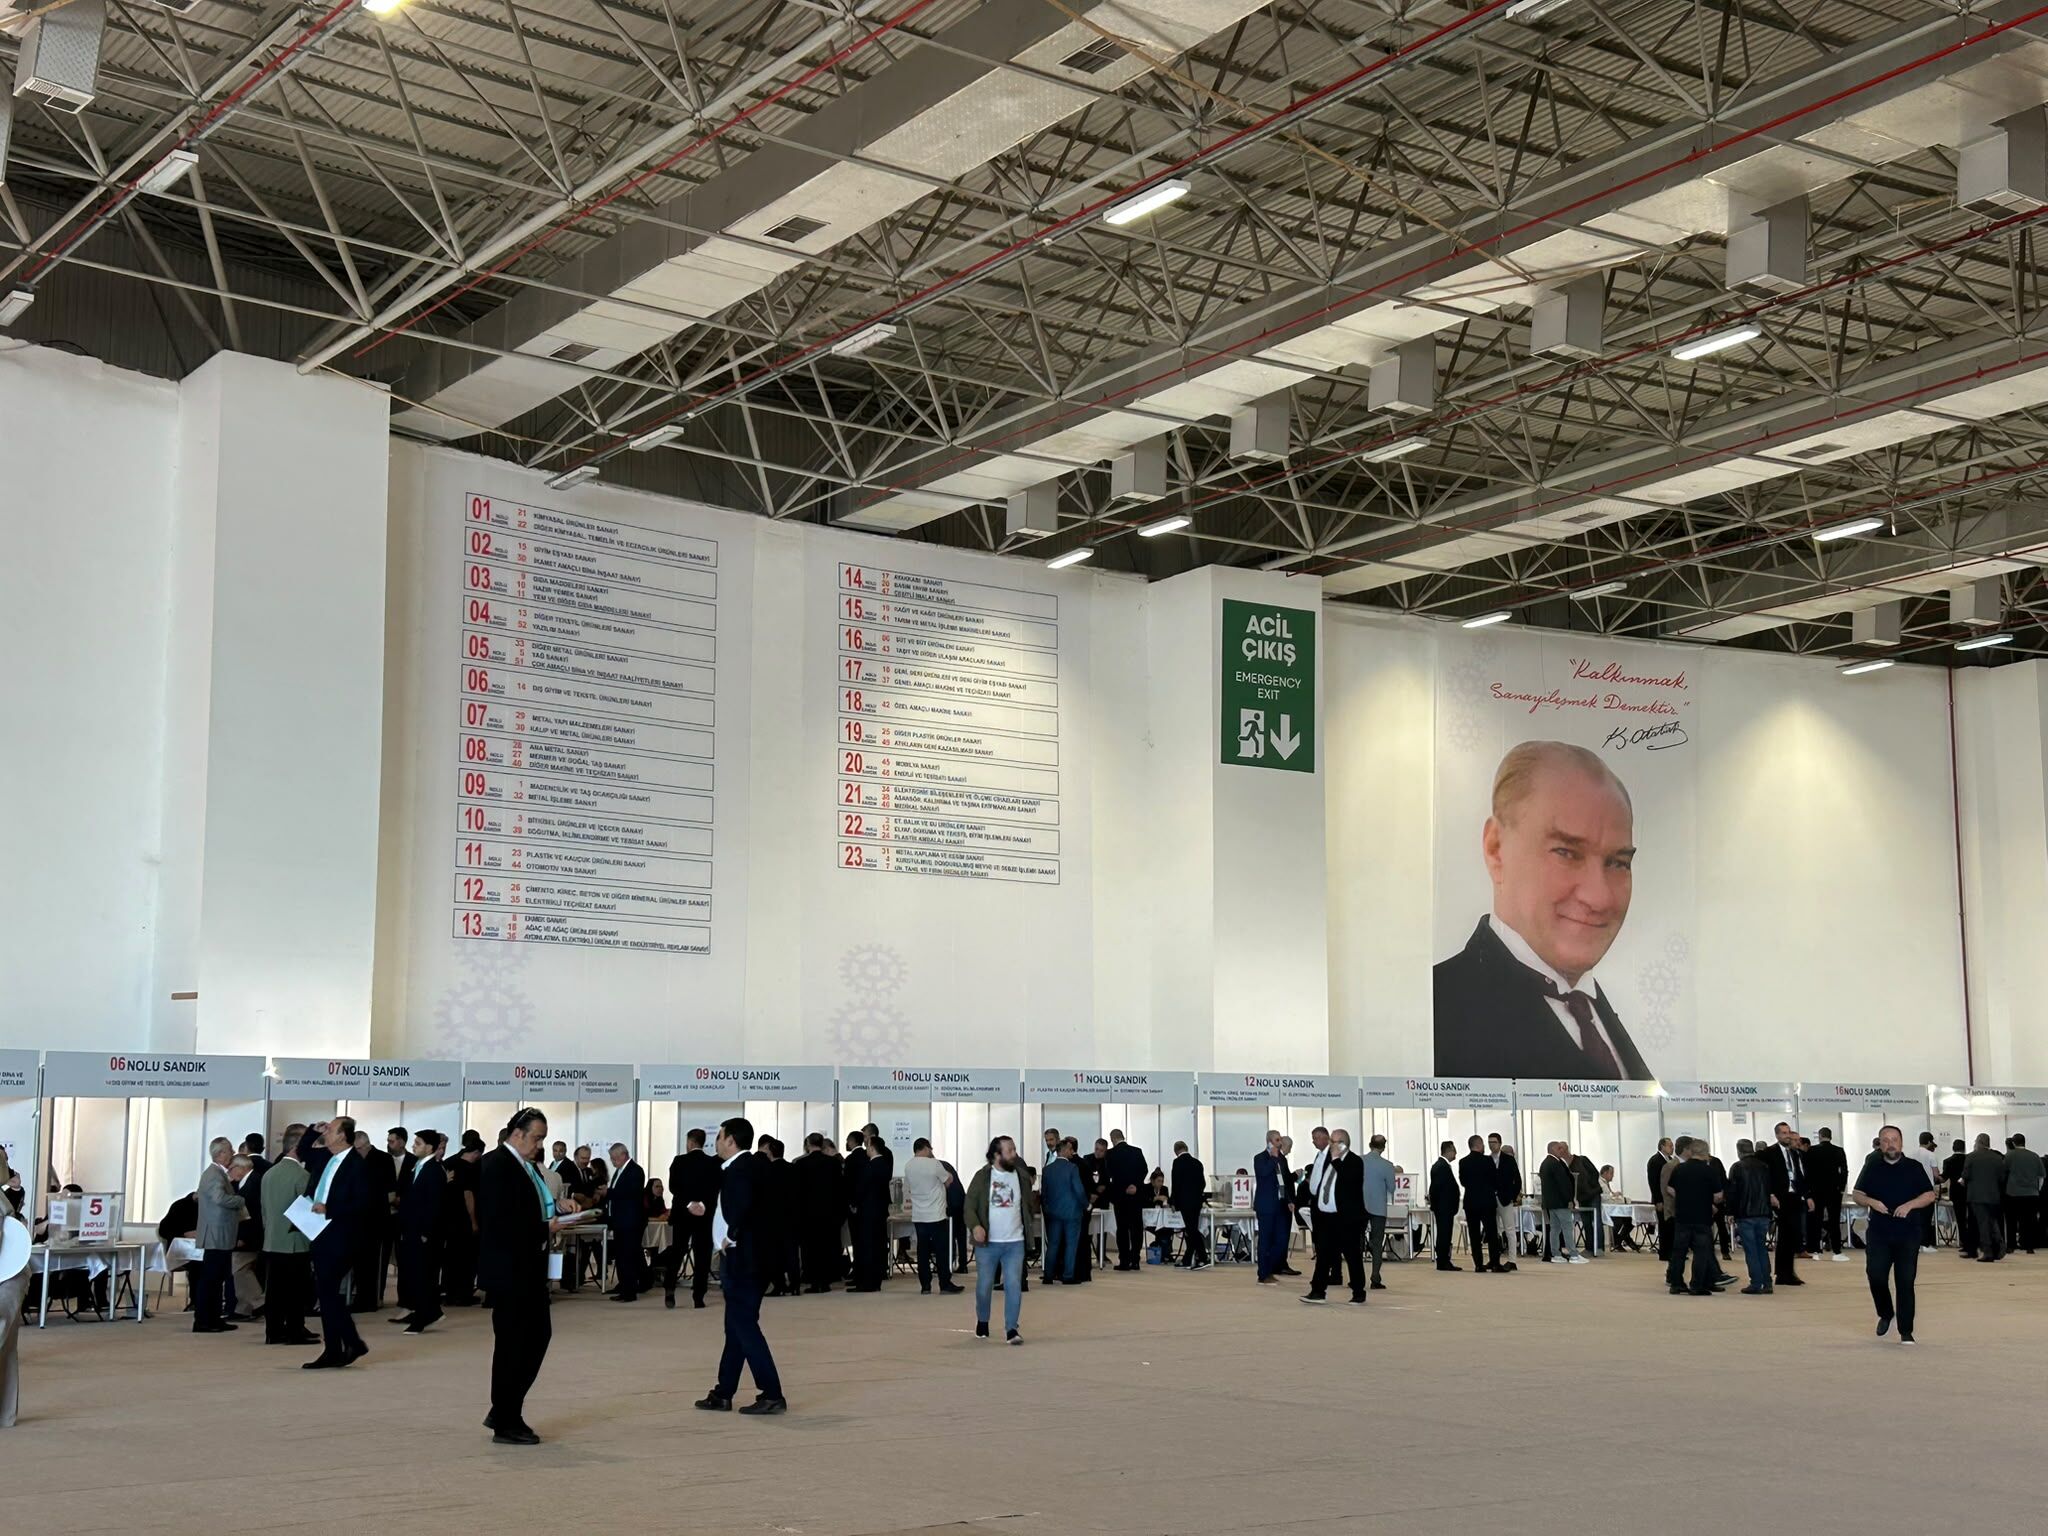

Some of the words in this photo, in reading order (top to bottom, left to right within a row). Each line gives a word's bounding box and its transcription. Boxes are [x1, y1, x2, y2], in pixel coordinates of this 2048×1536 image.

[472, 496, 490, 522] 01
[518, 509, 526, 517] 21
[518, 521, 527, 529] 22
[472, 531, 491, 556] 02
[470, 565, 491, 590] 03
[517, 581, 526, 589] 10
[846, 567, 862, 588] 14
[469, 600, 490, 624] 04
[518, 609, 527, 617] 13
[845, 598, 862, 619] 15
[517, 620, 527, 629] 52
[1246, 613, 1292, 638] ACİL
[469, 635, 489, 659] 05
[846, 628, 862, 650] 16
[1241, 638, 1296, 666] ÇIKIŞ
[846, 660, 862, 680] 17
[1236, 672, 1301, 688] EMERGENCY
[468, 669, 488, 692] 06
[846, 690, 862, 711] 18
[1258, 688, 1280, 700] EXIT
[1490, 682, 1597, 714] Sanayileşmek
[467, 703, 487, 727] 07
[515, 711, 525, 720] 29
[532, 714, 553, 724] METAL
[846, 721, 861, 742] 19
[466, 737, 486, 761] 08
[845, 752, 862, 773] 20
[464, 772, 485, 796] 09
[845, 783, 861, 804] 21
[465, 807, 484, 831] 10
[845, 814, 863, 836] 22
[465, 842, 482, 865] 11
[512, 849, 522, 857] 23
[845, 845, 862, 867] 23
[464, 878, 484, 901] 12
[511, 884, 521, 892] 26
[462, 912, 482, 936] 13
[110, 1057, 126, 1070] 06
[127, 1060, 160, 1072] NOLU
[163, 1061, 206, 1072] SANDIK
[328, 1062, 341, 1076] 07
[342, 1066, 370, 1076] NOLU
[373, 1066, 410, 1076] SANDIK
[515, 1066, 526, 1078] 08
[528, 1069, 551, 1079] NOLU
[554, 1069, 587, 1079] SANDIK
[696, 1068, 709, 1080] 09
[711, 1070, 739, 1080] NOLU
[742, 1071, 780, 1081] SANDIK
[892, 1070, 904, 1082] 10
[905, 1072, 931, 1082] NOLU
[934, 1073, 970, 1082] SANDIK
[1074, 1073, 1084, 1083] 11
[1086, 1075, 1111, 1084] NOLU
[1114, 1076, 1147, 1084] SANDIK
[1245, 1076, 1255, 1086] 12
[1257, 1078, 1280, 1088] NOLU
[1282, 1078, 1314, 1088] SANDIK
[1406, 1080, 1415, 1090] 13
[1416, 1082, 1438, 1091] NOLU
[1441, 1082, 1470, 1091] SANDIK
[1558, 1082, 1567, 1092] 14
[1568, 1083, 1589, 1092] NOLU
[1591, 1083, 1619, 1093] SANDIK
[1700, 1084, 1708, 1094] 15
[1709, 1086, 1729, 1094] NOLU
[1731, 1086, 1757, 1095] SANDIK
[1835, 1085, 1844, 1095] 16
[1844, 1087, 1863, 1096] NOLU
[1865, 1087, 1890, 1096] SANDIK
[1234, 1179, 1249, 1191] 11
[1394, 1177, 1410, 1189] 12
[90, 1198, 102, 1215] 5
